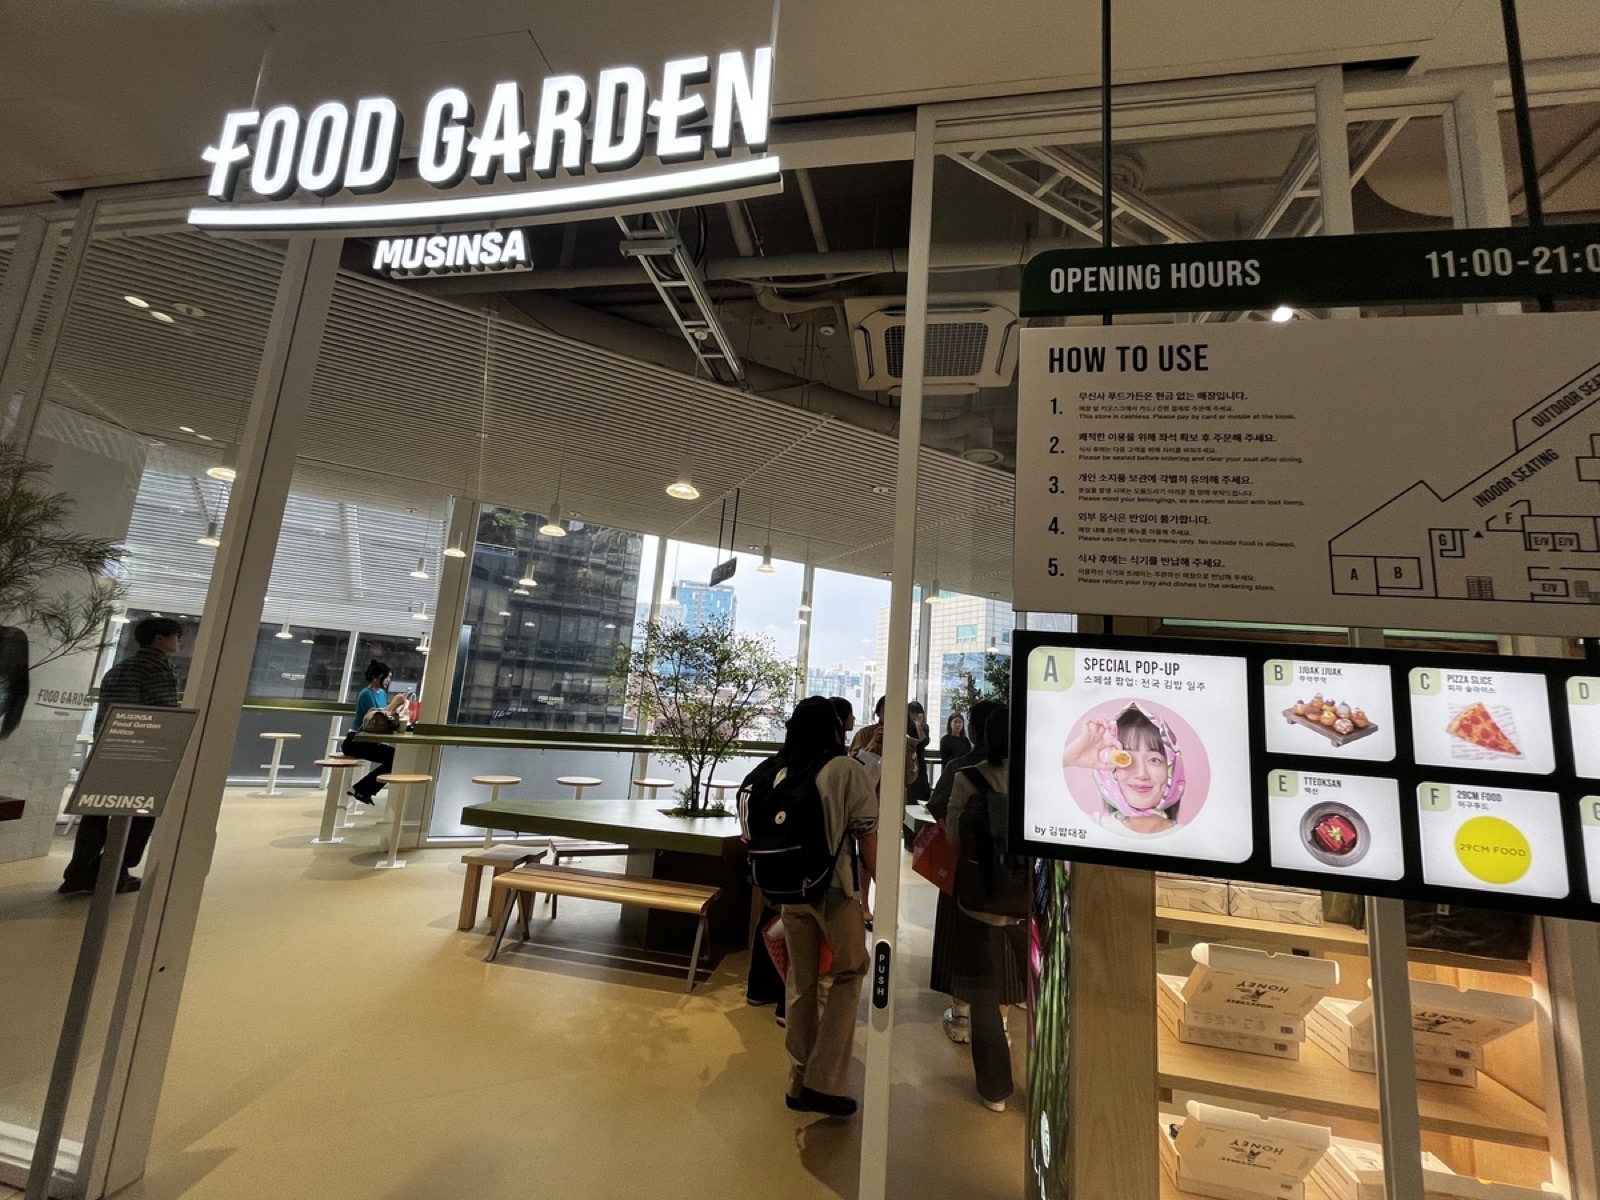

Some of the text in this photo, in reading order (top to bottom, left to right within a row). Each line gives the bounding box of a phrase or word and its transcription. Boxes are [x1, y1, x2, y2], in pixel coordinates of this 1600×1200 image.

[203, 46, 773, 197] FOOD GARDEN
[373, 229, 528, 272] MUSINSA
[1049, 262, 1161, 294] OPENING
[1170, 258, 1261, 290] HOURS
[1048, 343, 1209, 374] HOW TO USE
[1108, 391, 1153, 401] 푸드가든은
[1176, 391, 1194, 401] 없는
[1196, 391, 1250, 401] 매장입니다.
[1051, 398, 1064, 415] 1.
[1531, 391, 1584, 428] OUTDOOR
[1049, 436, 1065, 454] 2.
[1107, 432, 1136, 442] 이용을
[1138, 432, 1157, 442] 위해
[1200, 433, 1211, 442] 후
[1213, 433, 1243, 443] 주문해
[1244, 433, 1276, 442] 주세요.
[1049, 476, 1065, 494] 3.
[1078, 472, 1097, 482] 개인
[1128, 474, 1157, 483] 보관에
[1190, 475, 1220, 484] 유의해
[1222, 475, 1253, 485] 주세요.
[1473, 448, 1560, 508] INDOOR SEATING
[1048, 516, 1065, 535] 4.
[1078, 512, 1096, 521] 외부
[1128, 513, 1158, 524] 반입이
[1505, 512, 1512, 524] F
[1439, 535, 1447, 546] G
[1048, 557, 1064, 577] 5.
[1078, 553, 1224, 568] 식사 후에는 식기를 반납해 주세요.
[1350, 568, 1359, 581] A
[1394, 566, 1402, 579] B
[1043, 655, 1059, 683] A
[1084, 657, 1180, 676] SPECIAL POP-UP
[1274, 664, 1284, 681] B
[1084, 675, 1206, 692] 스페셜 팝업: 전국 김밥 일주
[1420, 673, 1430, 690] C
[1447, 674, 1492, 685] PIZZA SLICE
[38, 688, 60, 703] FOOD
[1465, 685, 1495, 694] 슬라이스
[1578, 682, 1590, 699] D
[1279, 775, 1287, 792] E
[1304, 777, 1342, 788] TTEOKSAN
[78, 794, 155, 809] MUSINSA
[1430, 788, 1440, 806] F
[1457, 790, 1502, 802] 29CM FOOD
[1034, 824, 1087, 840] by 김밥대장
[1459, 843, 1526, 857] 29CM FOOD
[877, 954, 886, 996] PUSH
[1236, 980, 1289, 995] HONEY
[1230, 1138, 1284, 1155] HONEY
